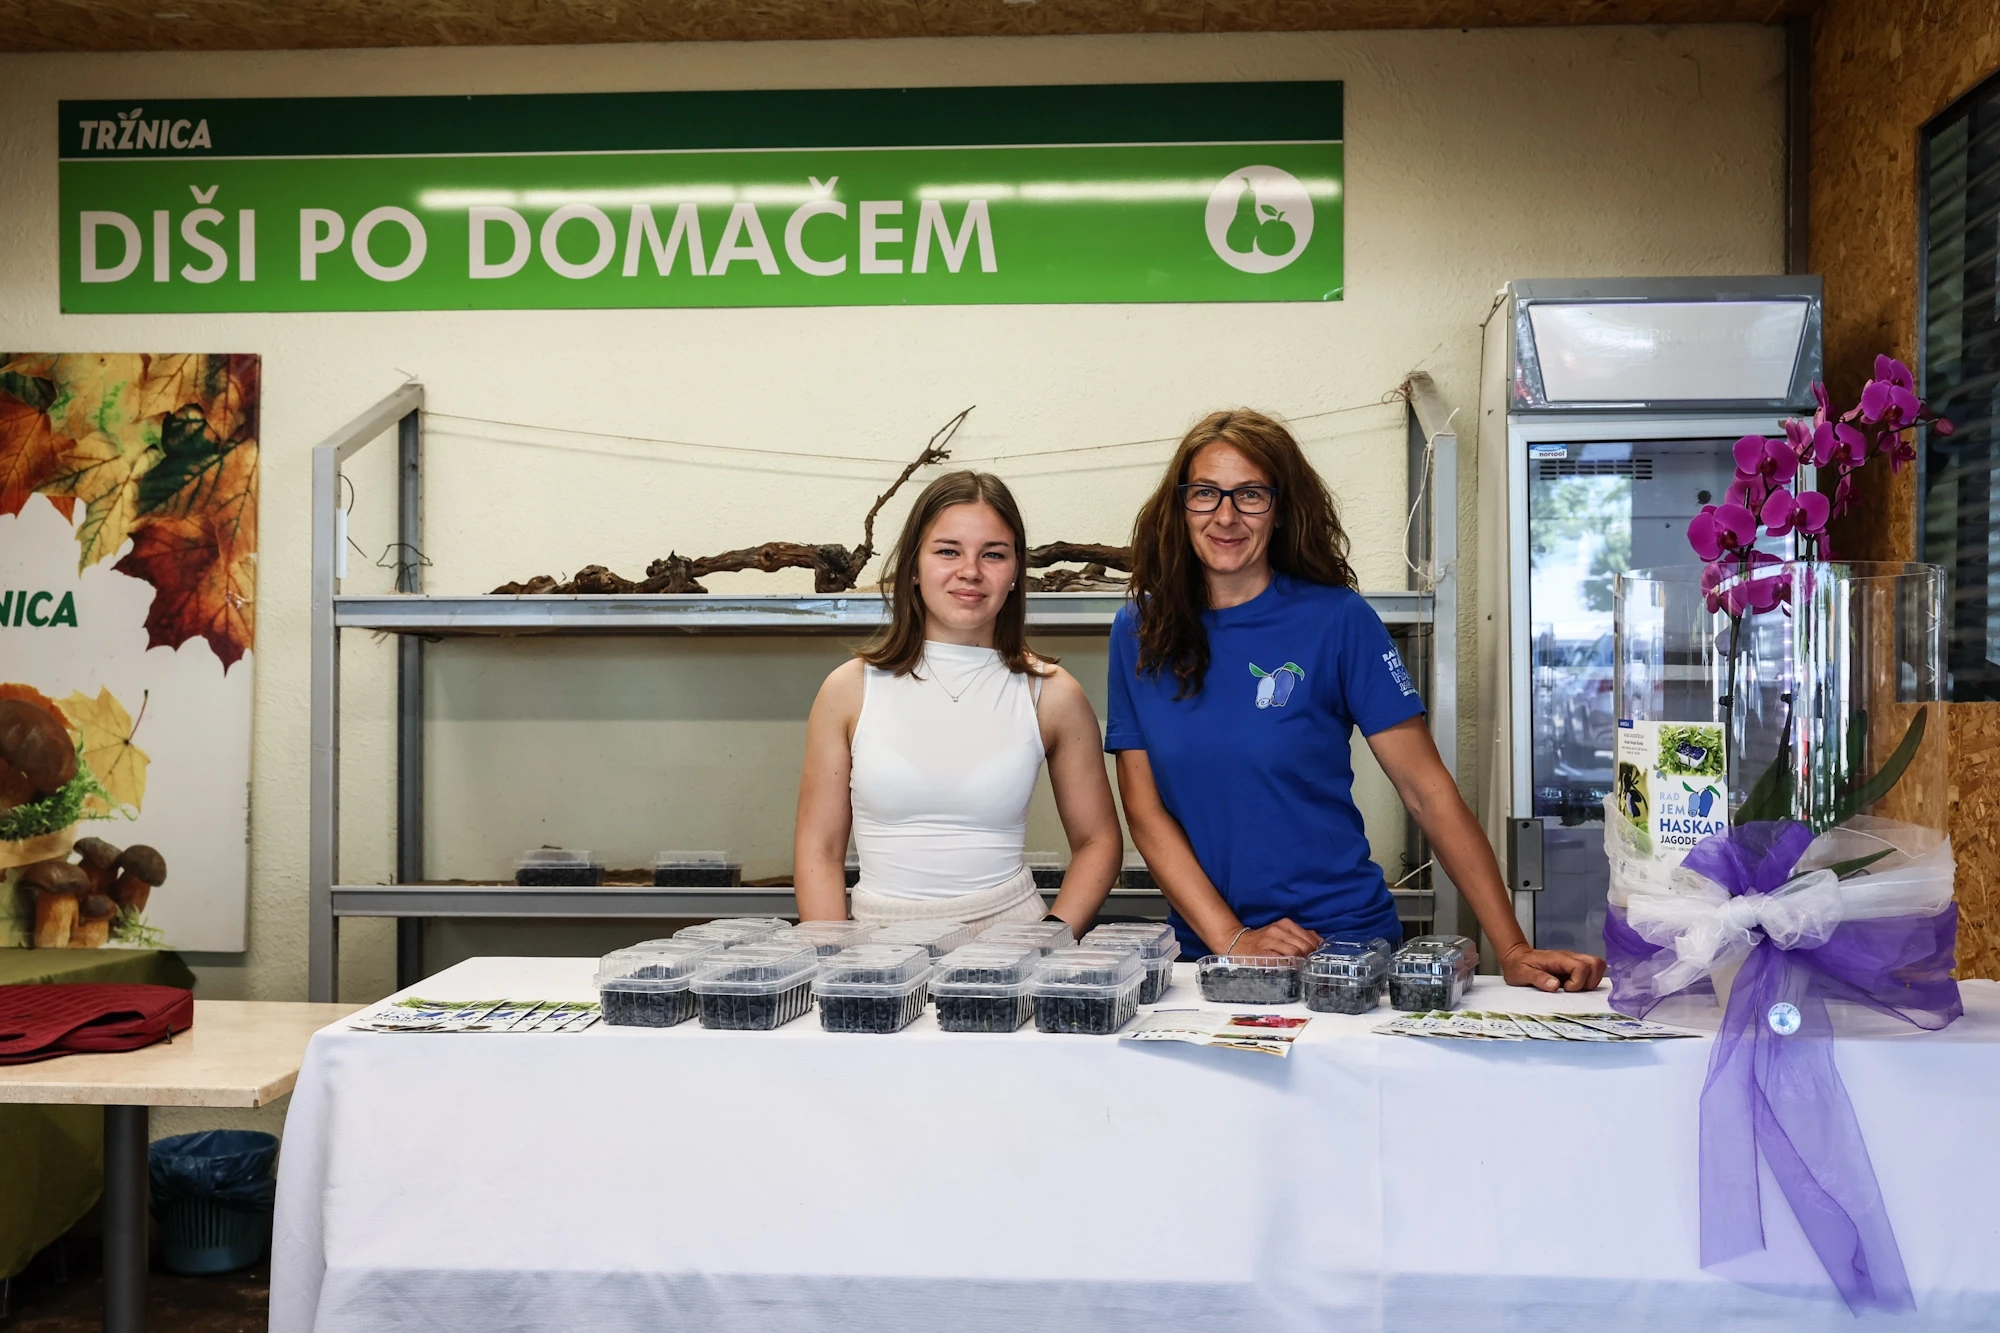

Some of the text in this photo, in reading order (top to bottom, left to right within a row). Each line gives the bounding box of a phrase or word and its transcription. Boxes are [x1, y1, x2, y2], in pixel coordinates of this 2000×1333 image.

[79, 108, 212, 150] TRŽNICA
[80, 176, 998, 284] DIŠI PO DOMAČEM
[1659, 792, 1680, 801] RAD
[1659, 803, 1685, 815] JEM
[1660, 835, 1697, 845] JAGODE
